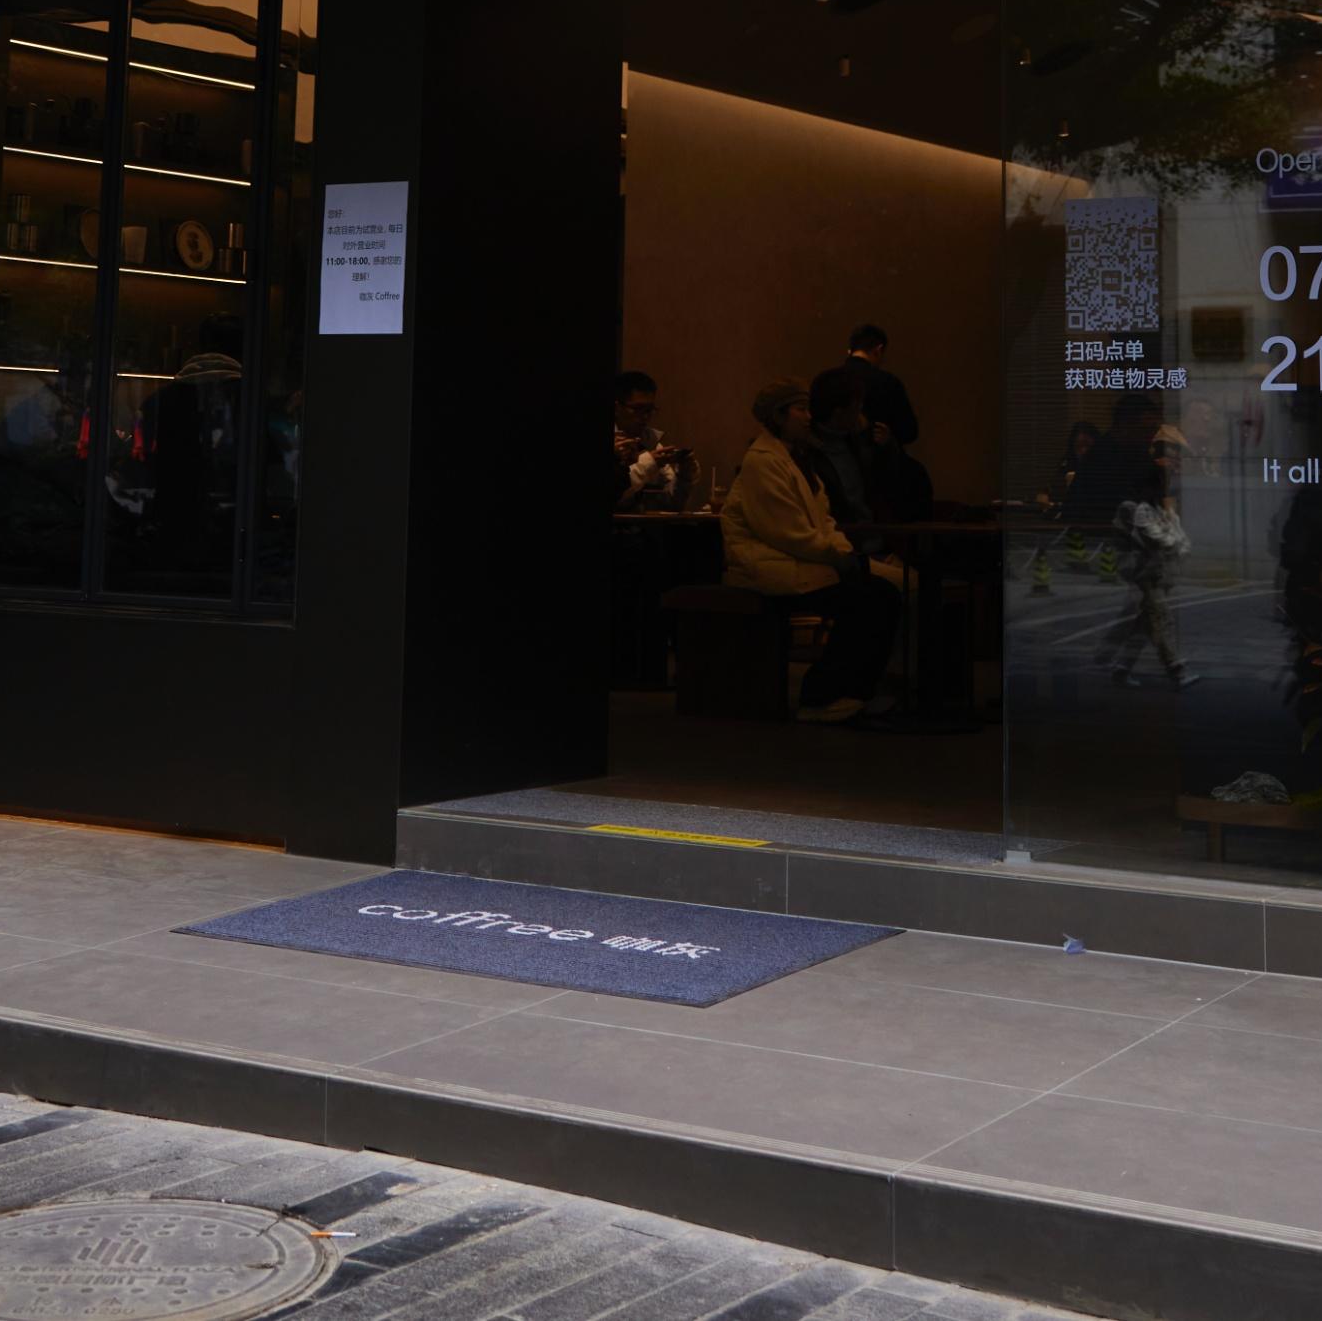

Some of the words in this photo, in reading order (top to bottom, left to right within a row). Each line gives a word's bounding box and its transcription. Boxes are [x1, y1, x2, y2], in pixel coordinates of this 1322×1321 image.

[1065, 340, 1145, 361] 扫码点单
[1065, 368, 1188, 390] 获取造物灵感
[1262, 458, 1281, 484] It
[1288, 458, 1319, 485] all
[358, 904, 594, 941] coffree
